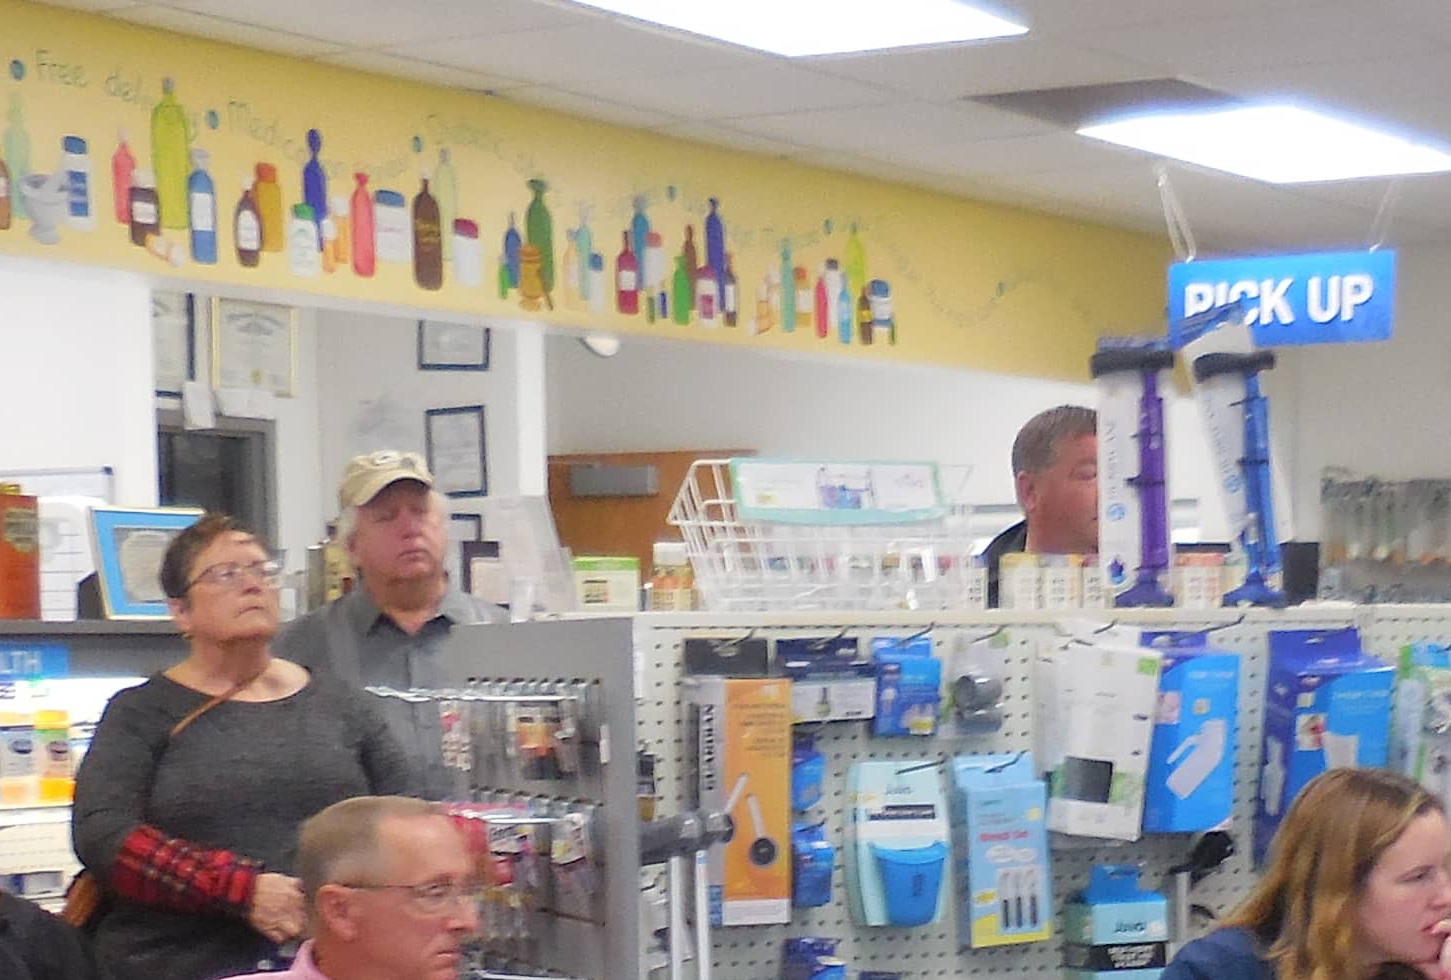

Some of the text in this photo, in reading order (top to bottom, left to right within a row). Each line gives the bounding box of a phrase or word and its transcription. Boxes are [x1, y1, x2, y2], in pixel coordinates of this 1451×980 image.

[35, 47, 90, 90] Free
[1184, 274, 1374, 326] PICK UP
